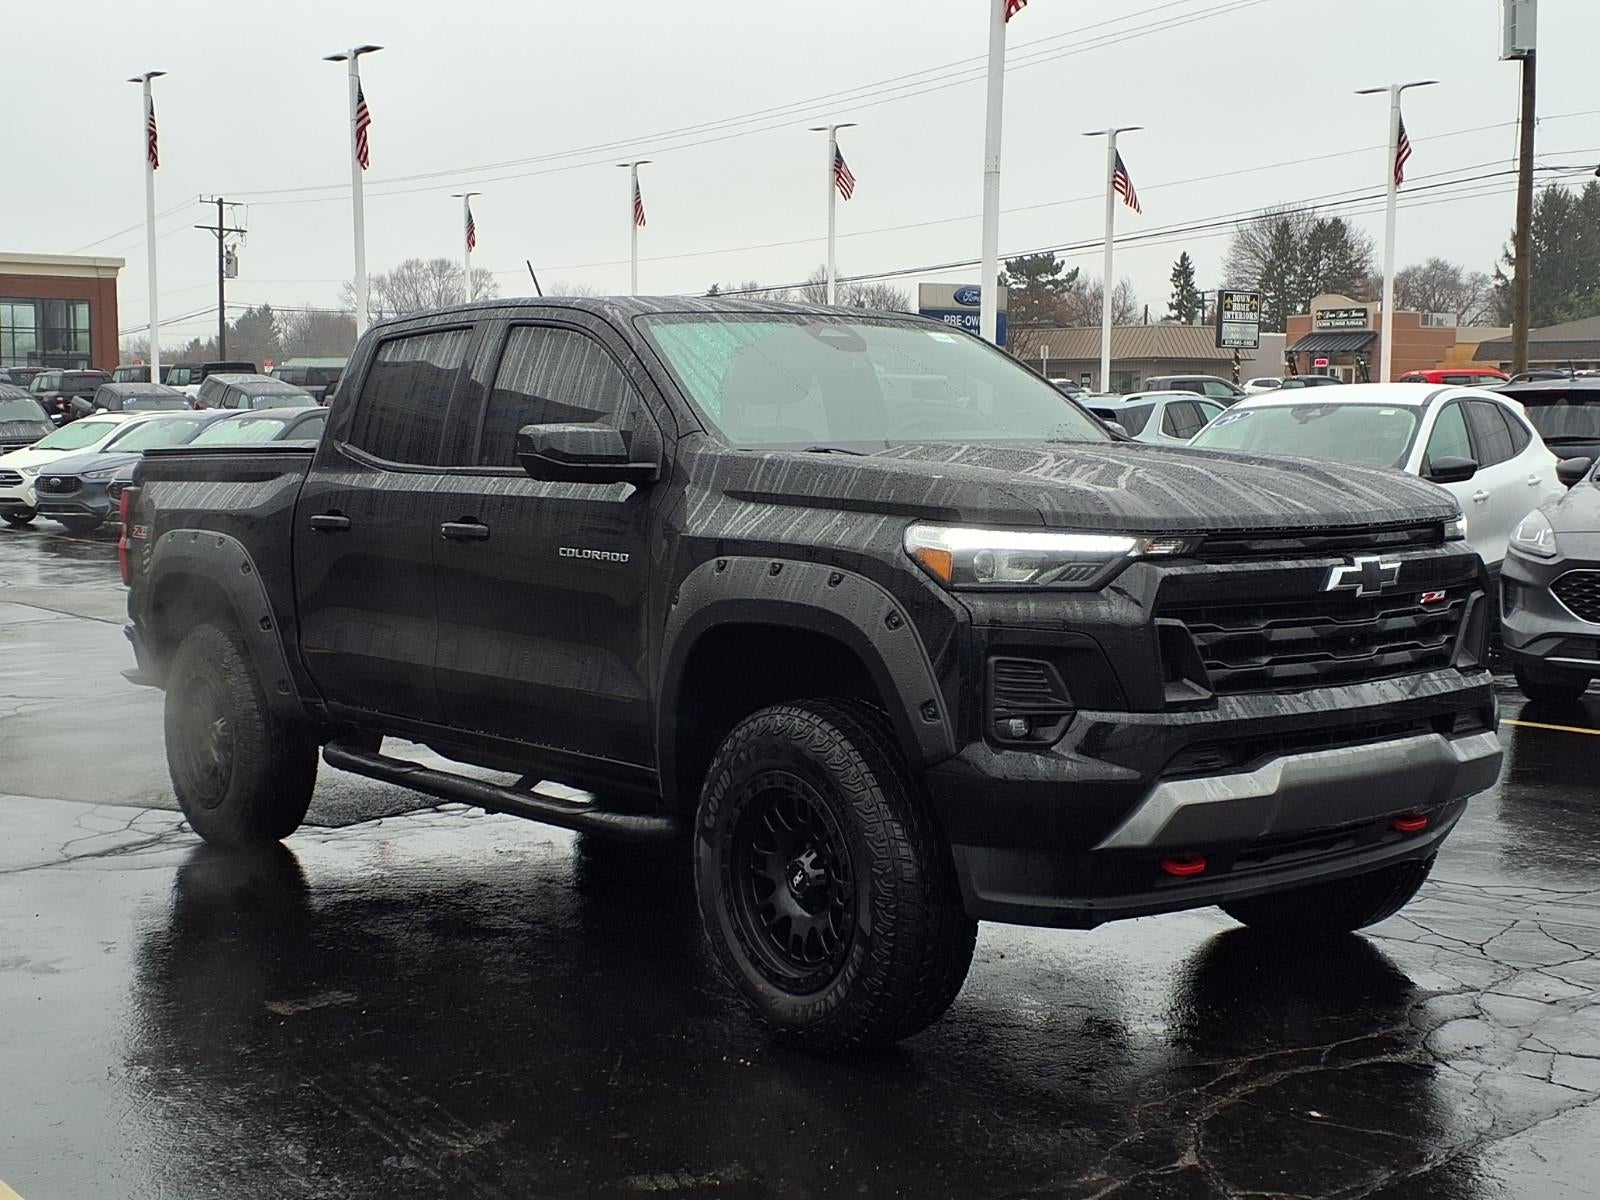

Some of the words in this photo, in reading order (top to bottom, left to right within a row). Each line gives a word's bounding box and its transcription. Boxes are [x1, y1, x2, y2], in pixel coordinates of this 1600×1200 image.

[1232, 294, 1250, 303] DOWN
[1232, 303, 1250, 311] HOME
[943, 314, 981, 326] PRE-OW
[1224, 311, 1258, 320] INTERIORS
[558, 547, 630, 563] COLORADO
